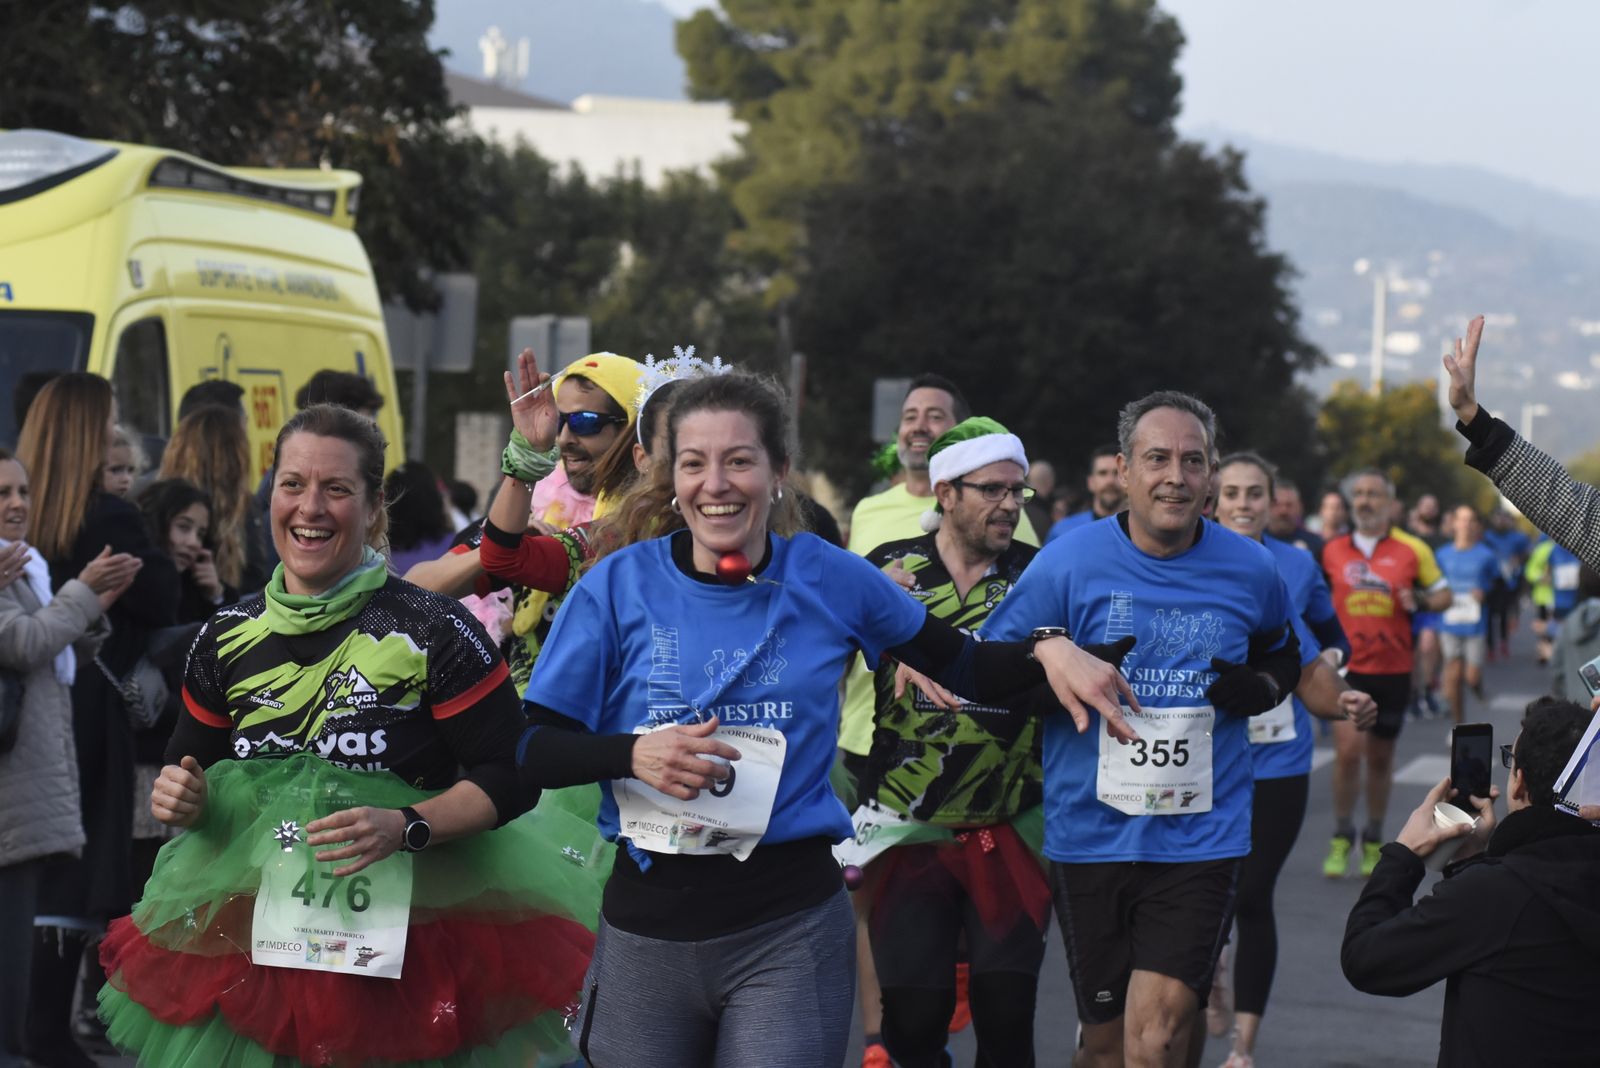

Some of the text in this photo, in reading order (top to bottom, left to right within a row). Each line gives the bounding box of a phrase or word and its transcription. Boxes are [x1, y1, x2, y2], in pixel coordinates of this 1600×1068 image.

[1134, 667, 1214, 686] SILVESTRE
[1130, 738, 1189, 768] 355
[291, 870, 372, 912] 476
[265, 940, 302, 952] IMDECO
